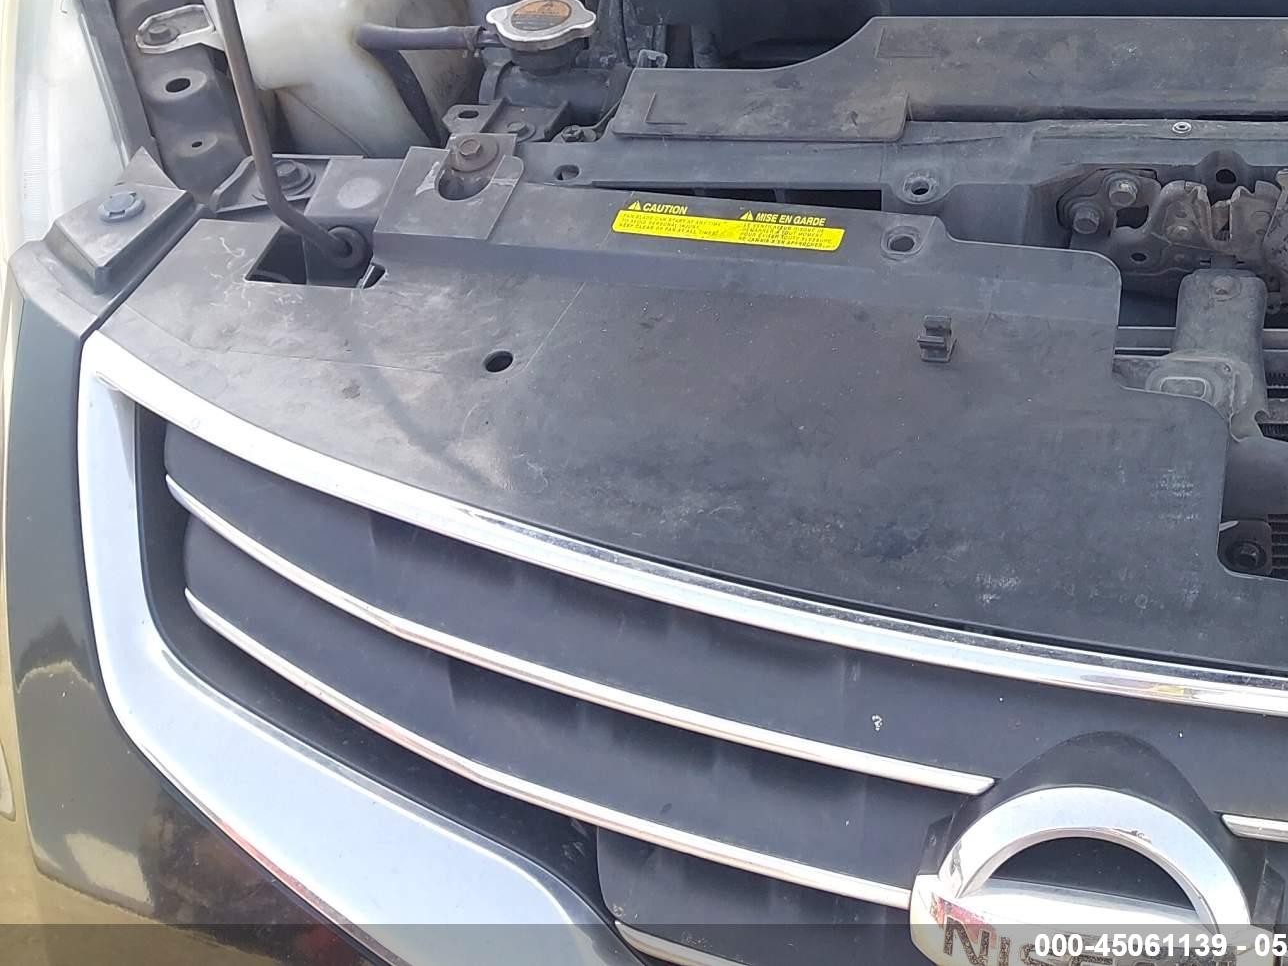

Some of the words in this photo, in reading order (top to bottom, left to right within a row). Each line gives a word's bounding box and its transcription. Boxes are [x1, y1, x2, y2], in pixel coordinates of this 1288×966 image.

[643, 203, 688, 215] CAUTION
[755, 212, 778, 223] MISE
[778, 214, 793, 224] EN
[793, 216, 827, 227] GARDE
